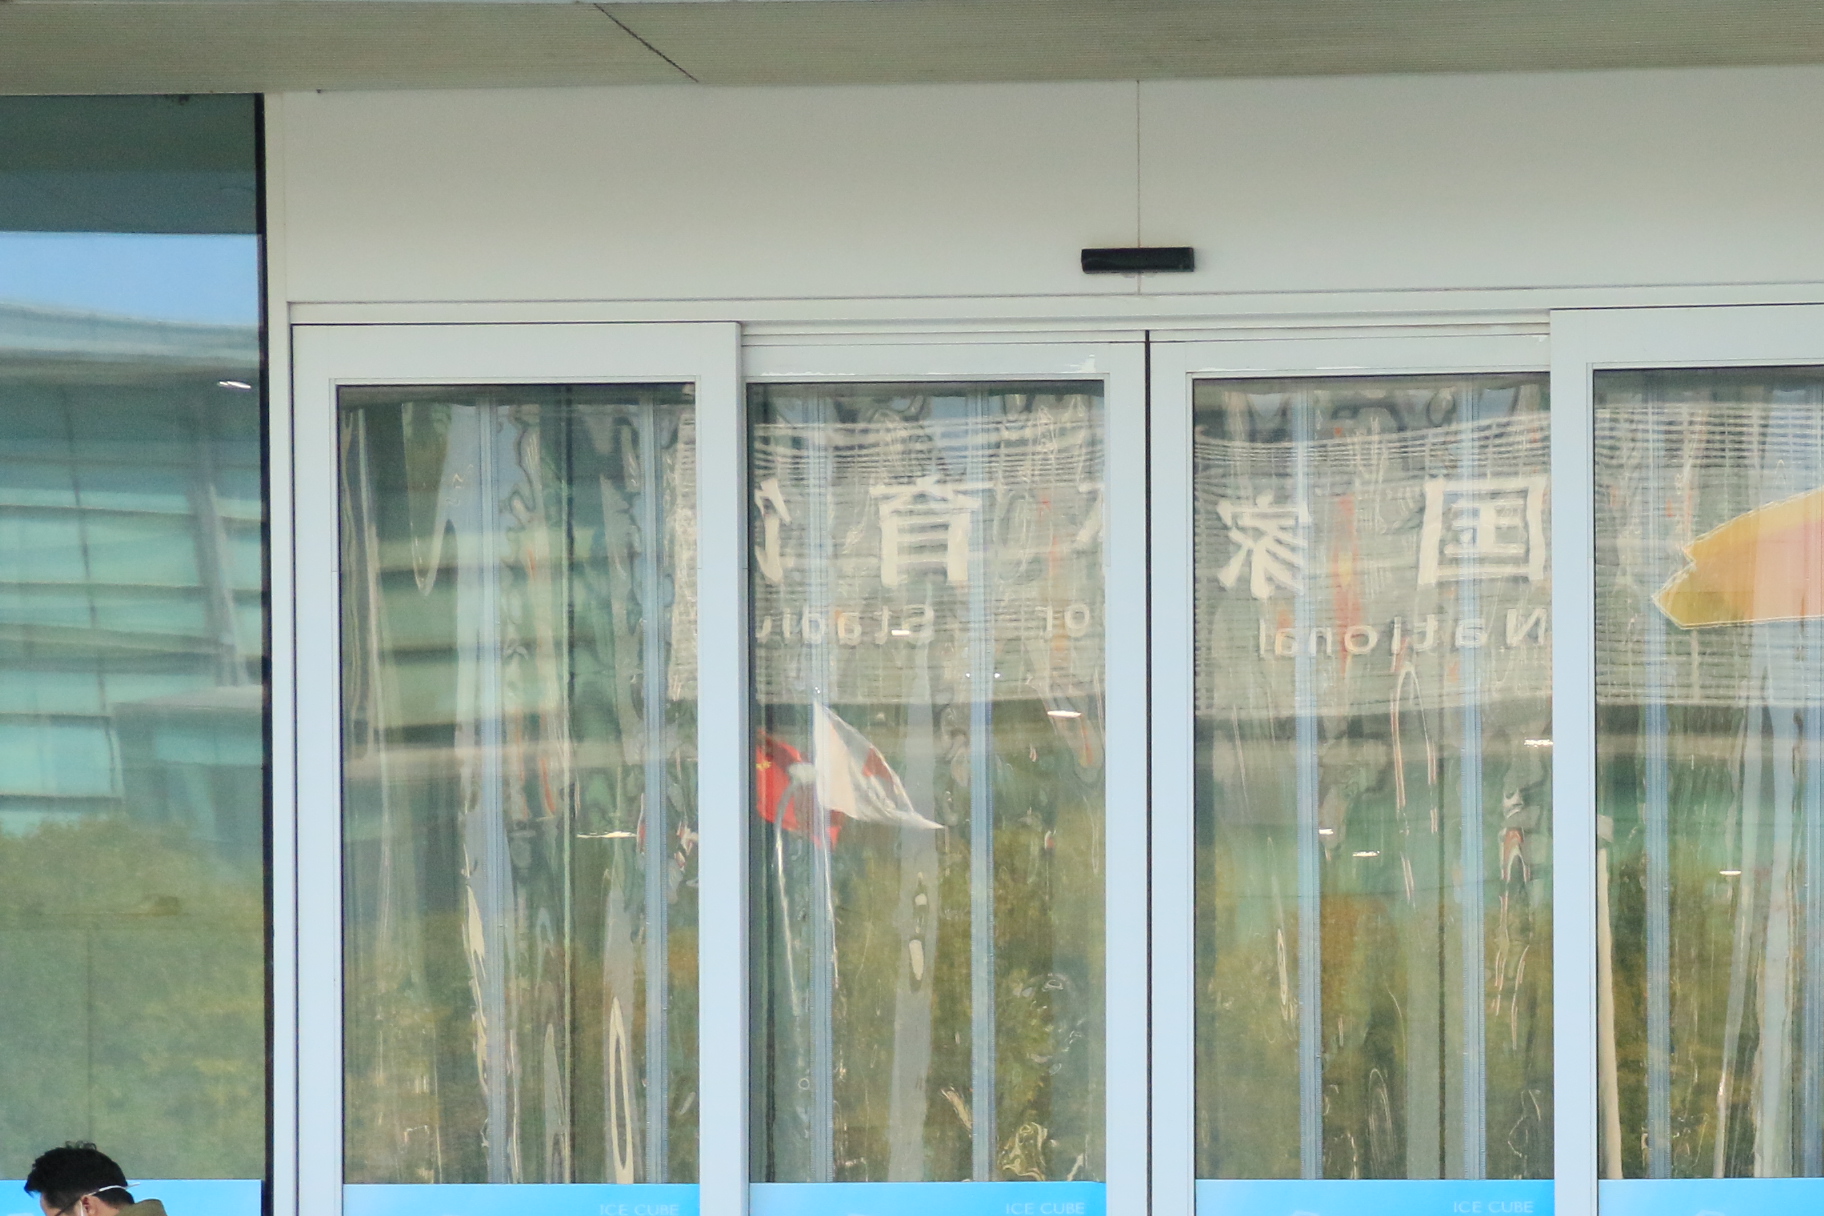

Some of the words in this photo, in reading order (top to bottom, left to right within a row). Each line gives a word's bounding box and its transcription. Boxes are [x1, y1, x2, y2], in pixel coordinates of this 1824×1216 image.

[600, 1203, 628, 1216] ICE
[634, 1203, 679, 1216] CUBE
[1006, 1202, 1034, 1215] ICE
[1040, 1202, 1085, 1215] CUBE
[1453, 1201, 1482, 1213] ICE
[1488, 1201, 1534, 1213] CUBE
